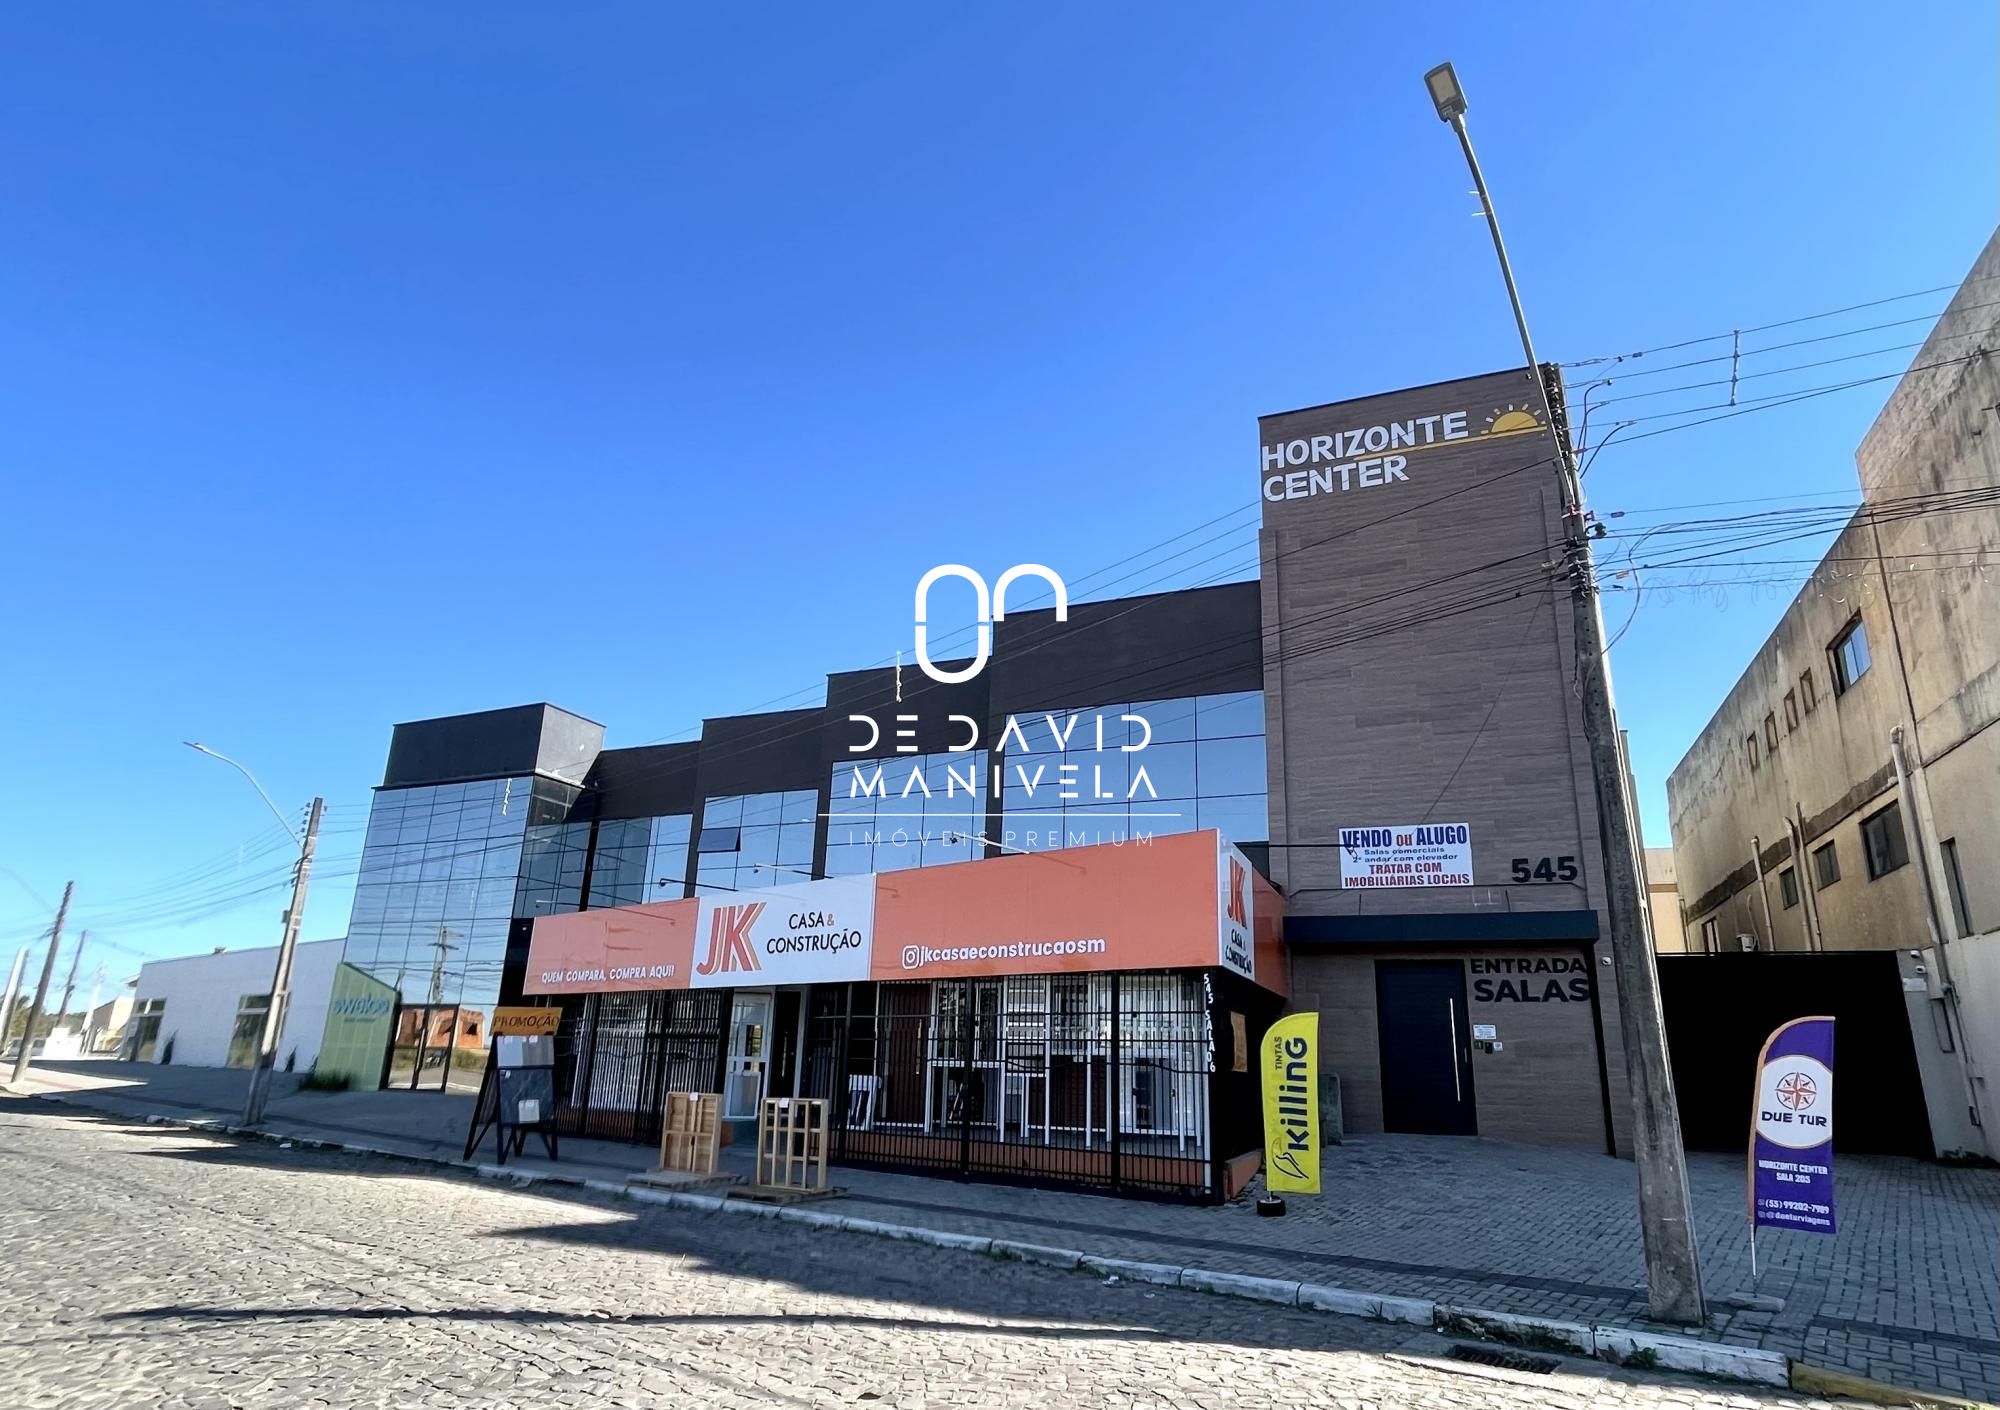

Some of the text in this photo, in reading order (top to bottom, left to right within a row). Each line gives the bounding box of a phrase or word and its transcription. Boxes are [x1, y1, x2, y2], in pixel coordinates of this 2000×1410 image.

[1262, 410, 1469, 471] HORIZONTE
[1263, 455, 1410, 502] CENTER
[1342, 829, 1392, 848] VENDO
[1416, 825, 1467, 846] ALUGO
[1345, 873, 1470, 887] IMOBILIÁRIAS LOCAIS
[1369, 862, 1442, 875] TRATAR COM
[1511, 855, 1578, 883] 545
[788, 911, 835, 930] CASA &
[696, 901, 767, 976] JK
[766, 928, 862, 954] CONSTRUÇÃO
[919, 938, 1105, 966] jkcasaeconstrucaosm
[542, 971, 563, 984] QUEM
[566, 969, 606, 982] COMPARA,
[609, 966, 646, 979] COMPRA
[1470, 957, 1587, 974] ENTRADA
[1474, 978, 1590, 1003] SALAS
[493, 1012, 561, 1028] PROMOÇÃO
[1274, 1036, 1283, 1070] TINTAS
[1761, 1111, 1827, 1127] DUE TUR
[1776, 1172, 1794, 1182] SALA
